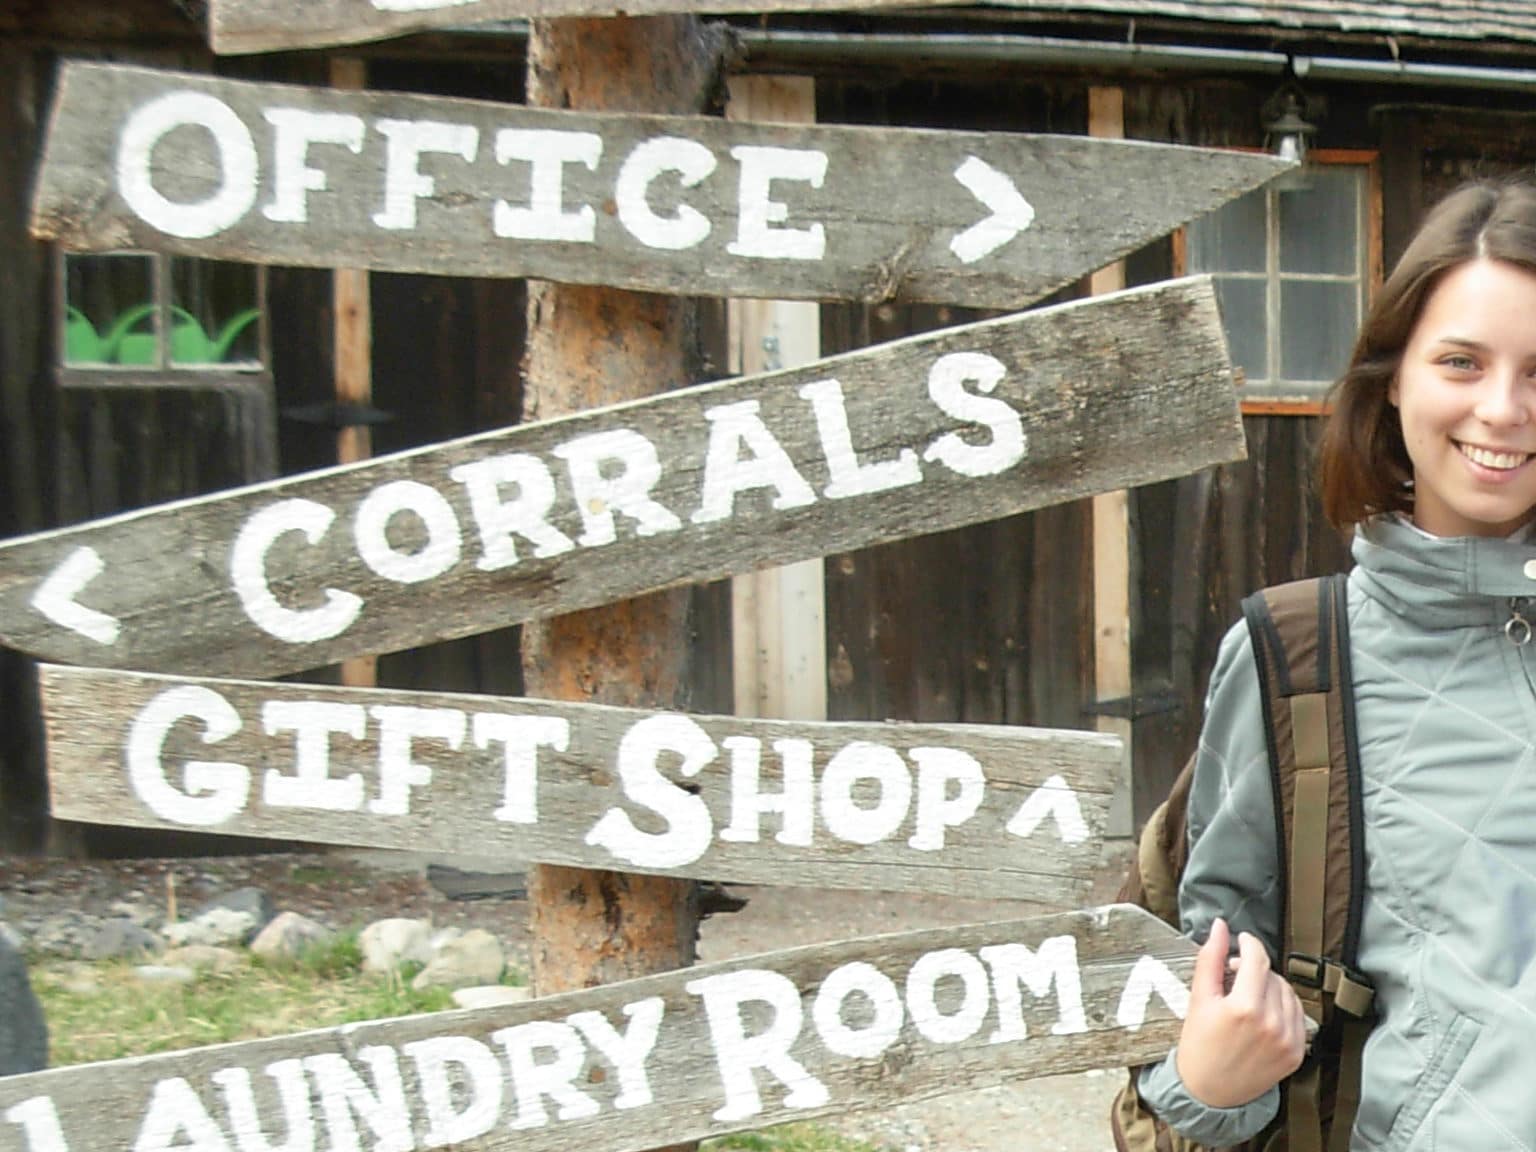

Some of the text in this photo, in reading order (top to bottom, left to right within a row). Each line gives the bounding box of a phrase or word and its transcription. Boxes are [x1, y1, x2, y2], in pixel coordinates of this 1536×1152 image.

[118, 91, 828, 259] OFFICE
[231, 353, 1026, 643] CORRALS
[125, 685, 985, 868] GIFT SHOP
[686, 936, 1091, 1122] ROOM
